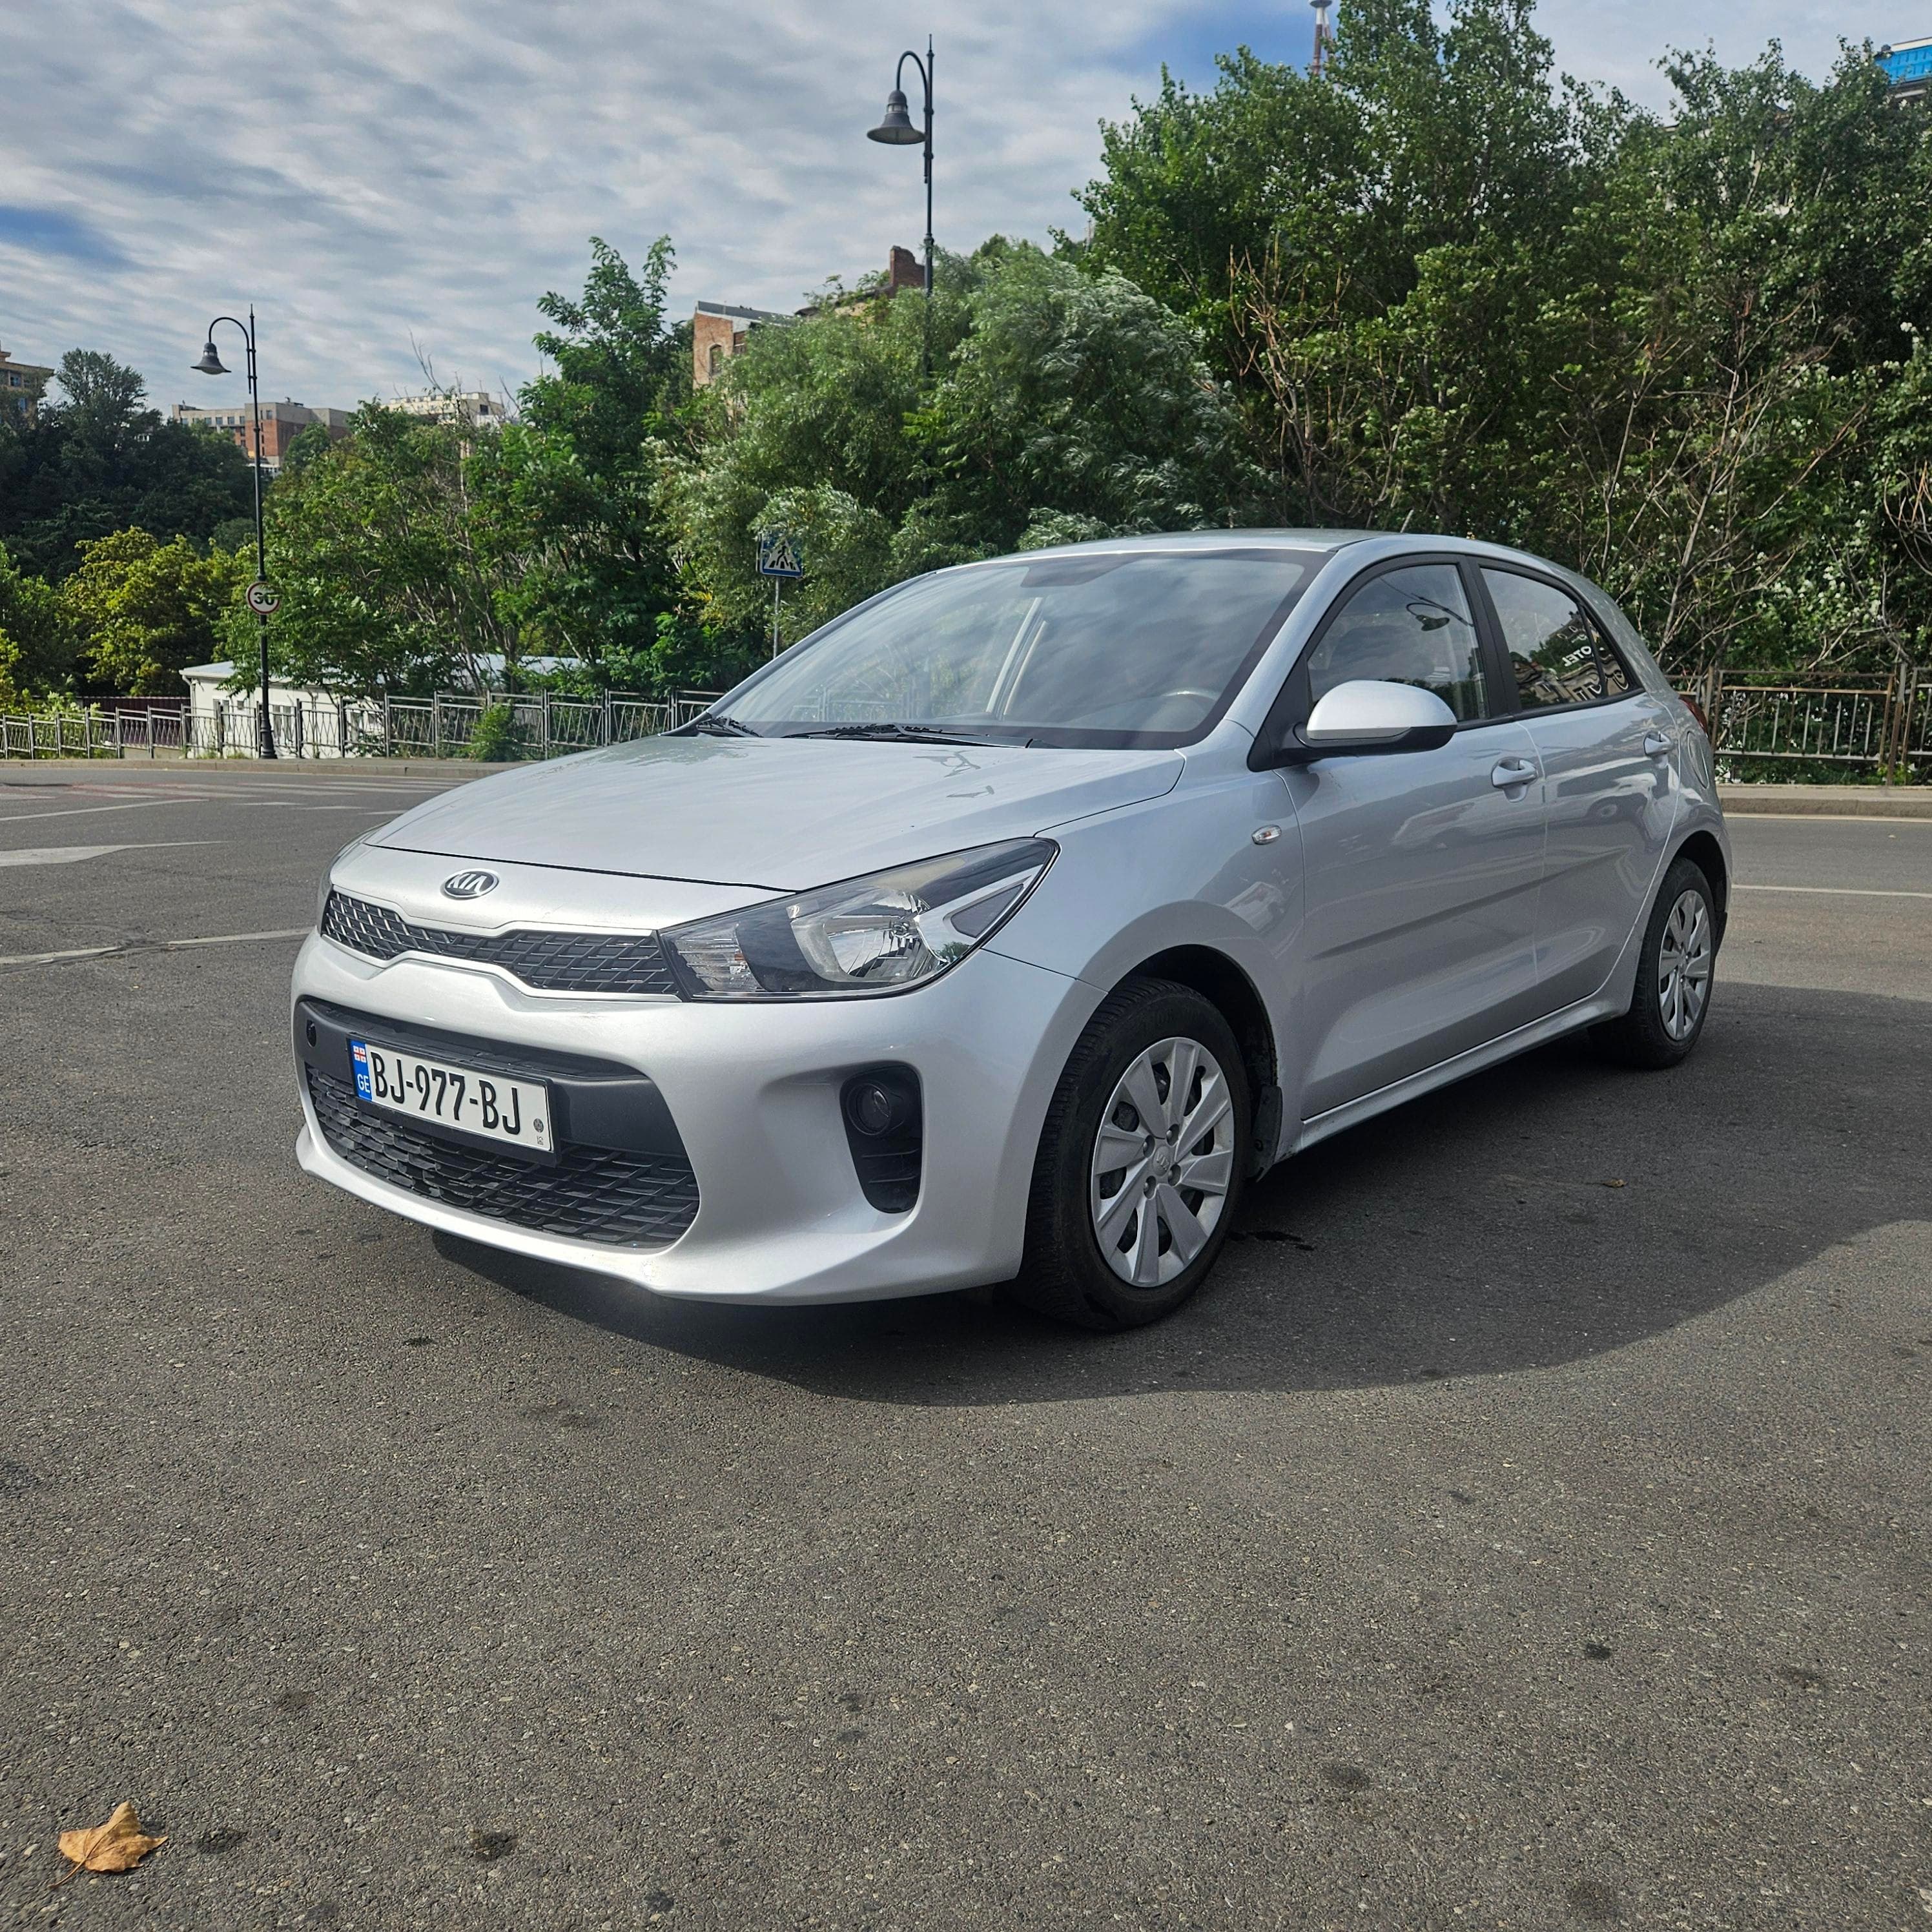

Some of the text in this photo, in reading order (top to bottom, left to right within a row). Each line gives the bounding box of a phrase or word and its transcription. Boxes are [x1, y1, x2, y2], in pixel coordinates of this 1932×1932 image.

[446, 872, 488, 895] KIA
[357, 1073, 371, 1093] GE
[371, 1051, 520, 1135] BJ-977-BJ
